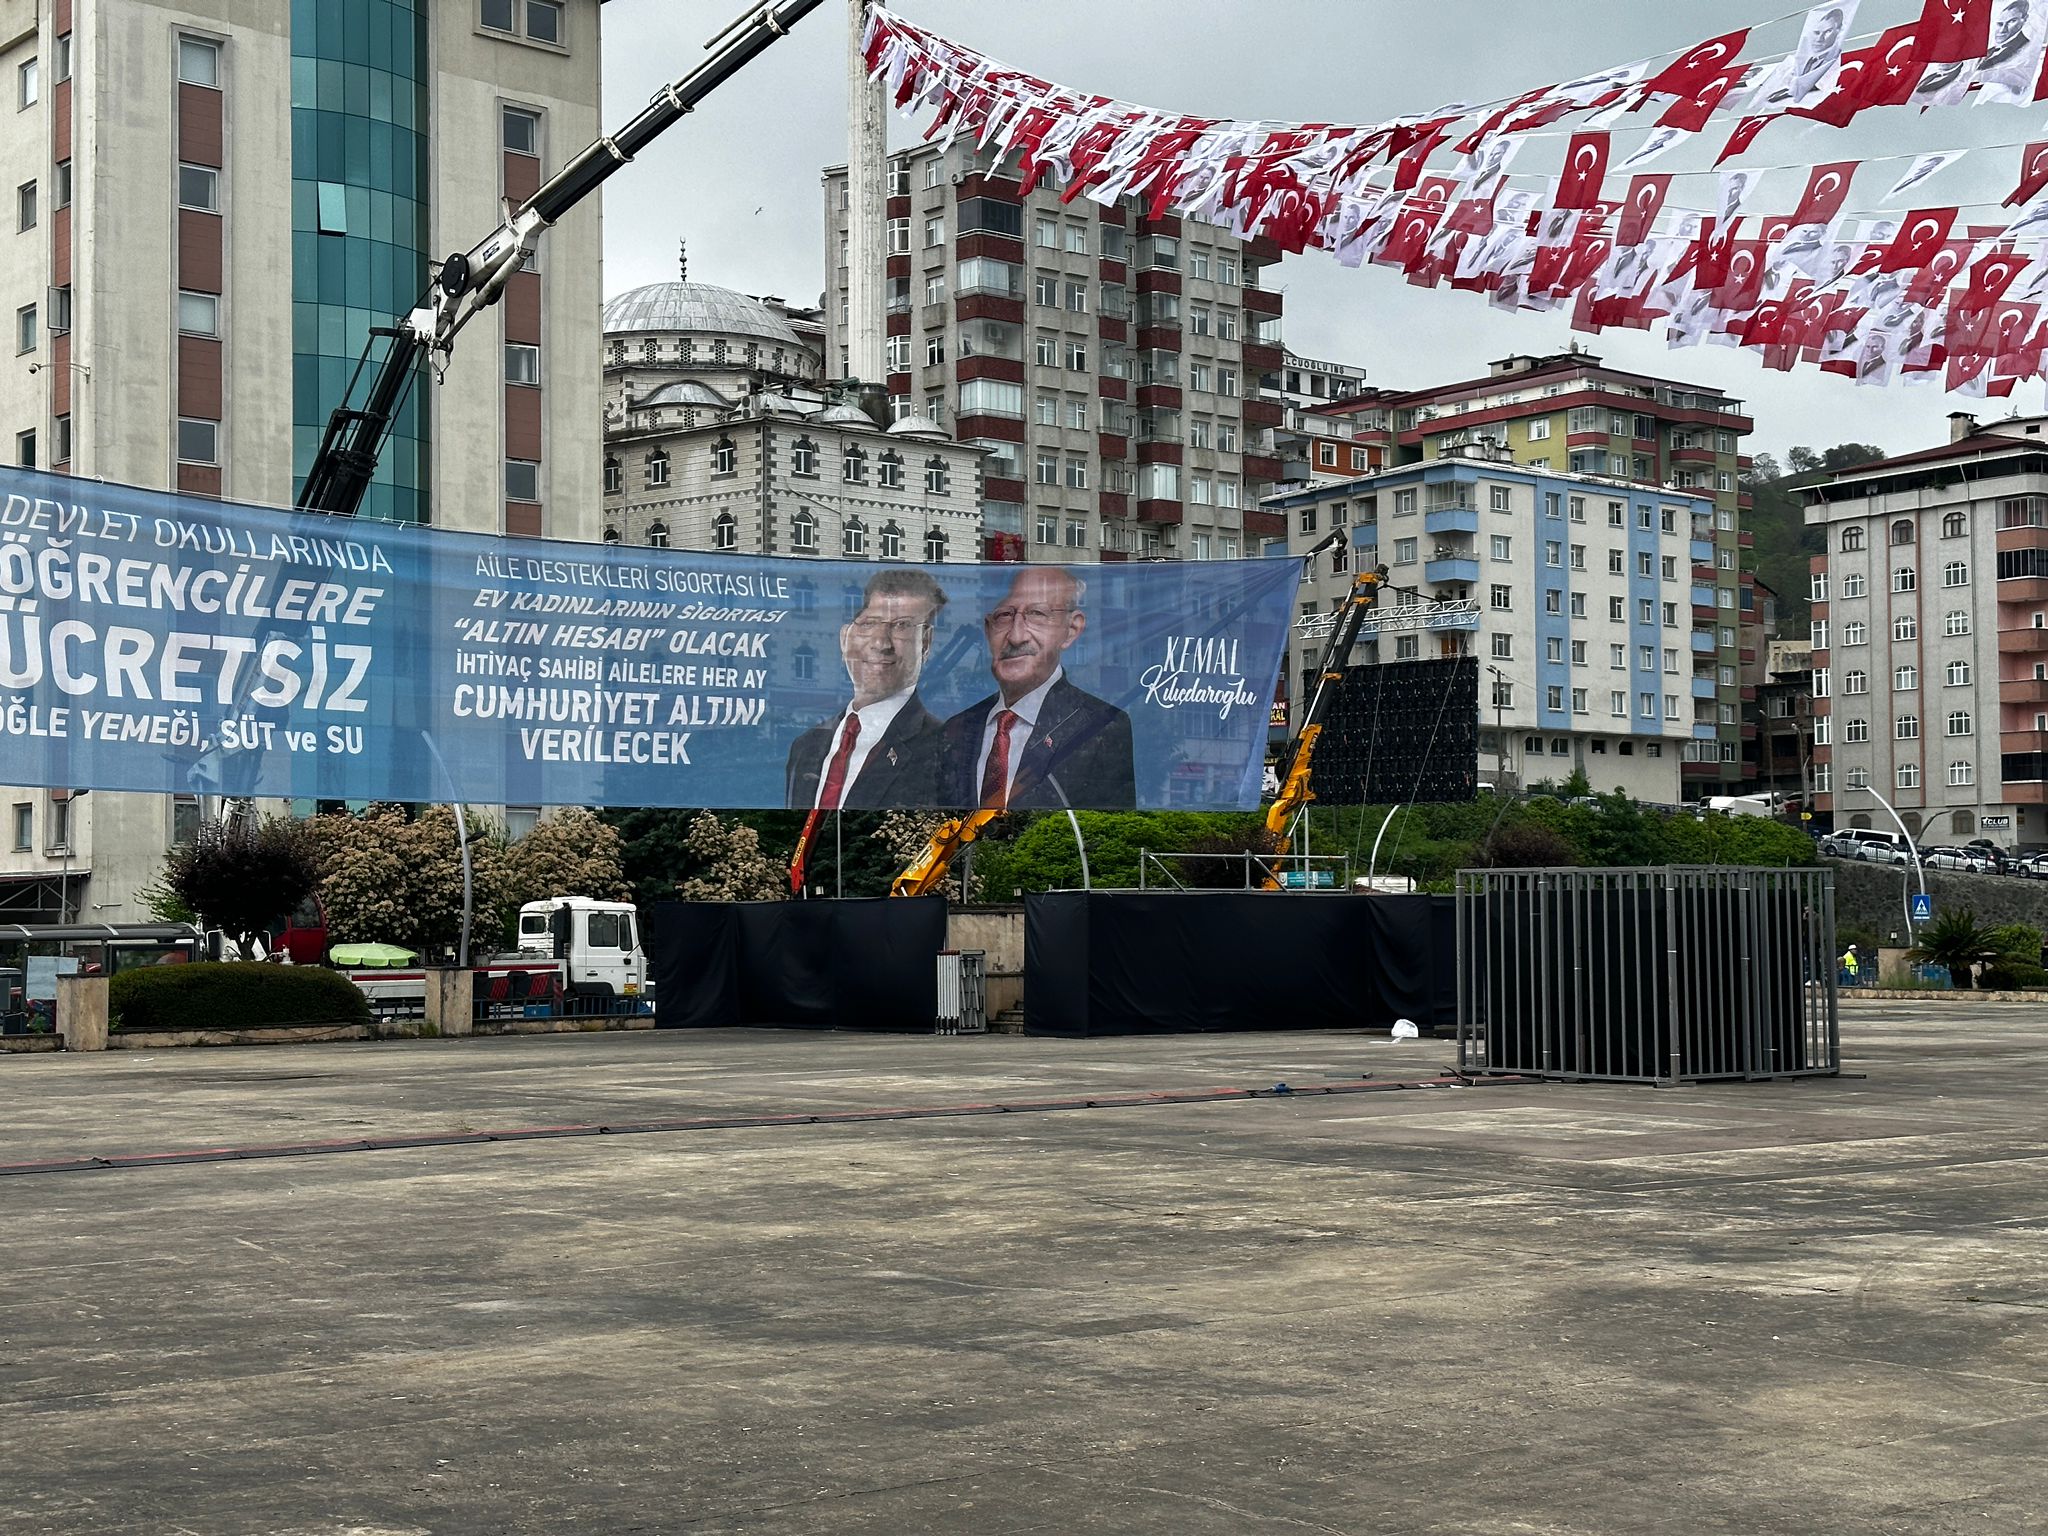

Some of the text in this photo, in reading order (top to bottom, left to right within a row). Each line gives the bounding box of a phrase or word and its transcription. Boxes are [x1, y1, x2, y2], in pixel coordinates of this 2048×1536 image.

[2, 494, 394, 574] DEVLET OKULLARINDA
[0, 532, 384, 625] ÖĞRENCİLERE
[476, 551, 790, 599] AİLE DESTEKLERİ SİGORTASI İLE
[473, 588, 788, 623] EV KADINLARININ SİGORTASI
[0, 597, 372, 712] ÜCRETSİZ
[669, 630, 770, 658] OLACAK
[1163, 636, 1241, 676] KEMAL
[456, 648, 768, 689] İHTİYAÇ SAHİBİ AİLELERE HER AY
[0, 696, 363, 753] ĞLE YEMEĞİ, SÜT ve SU
[453, 682, 766, 726] CUMHURİYET ALTINI
[520, 724, 692, 765] VERİLECEK
